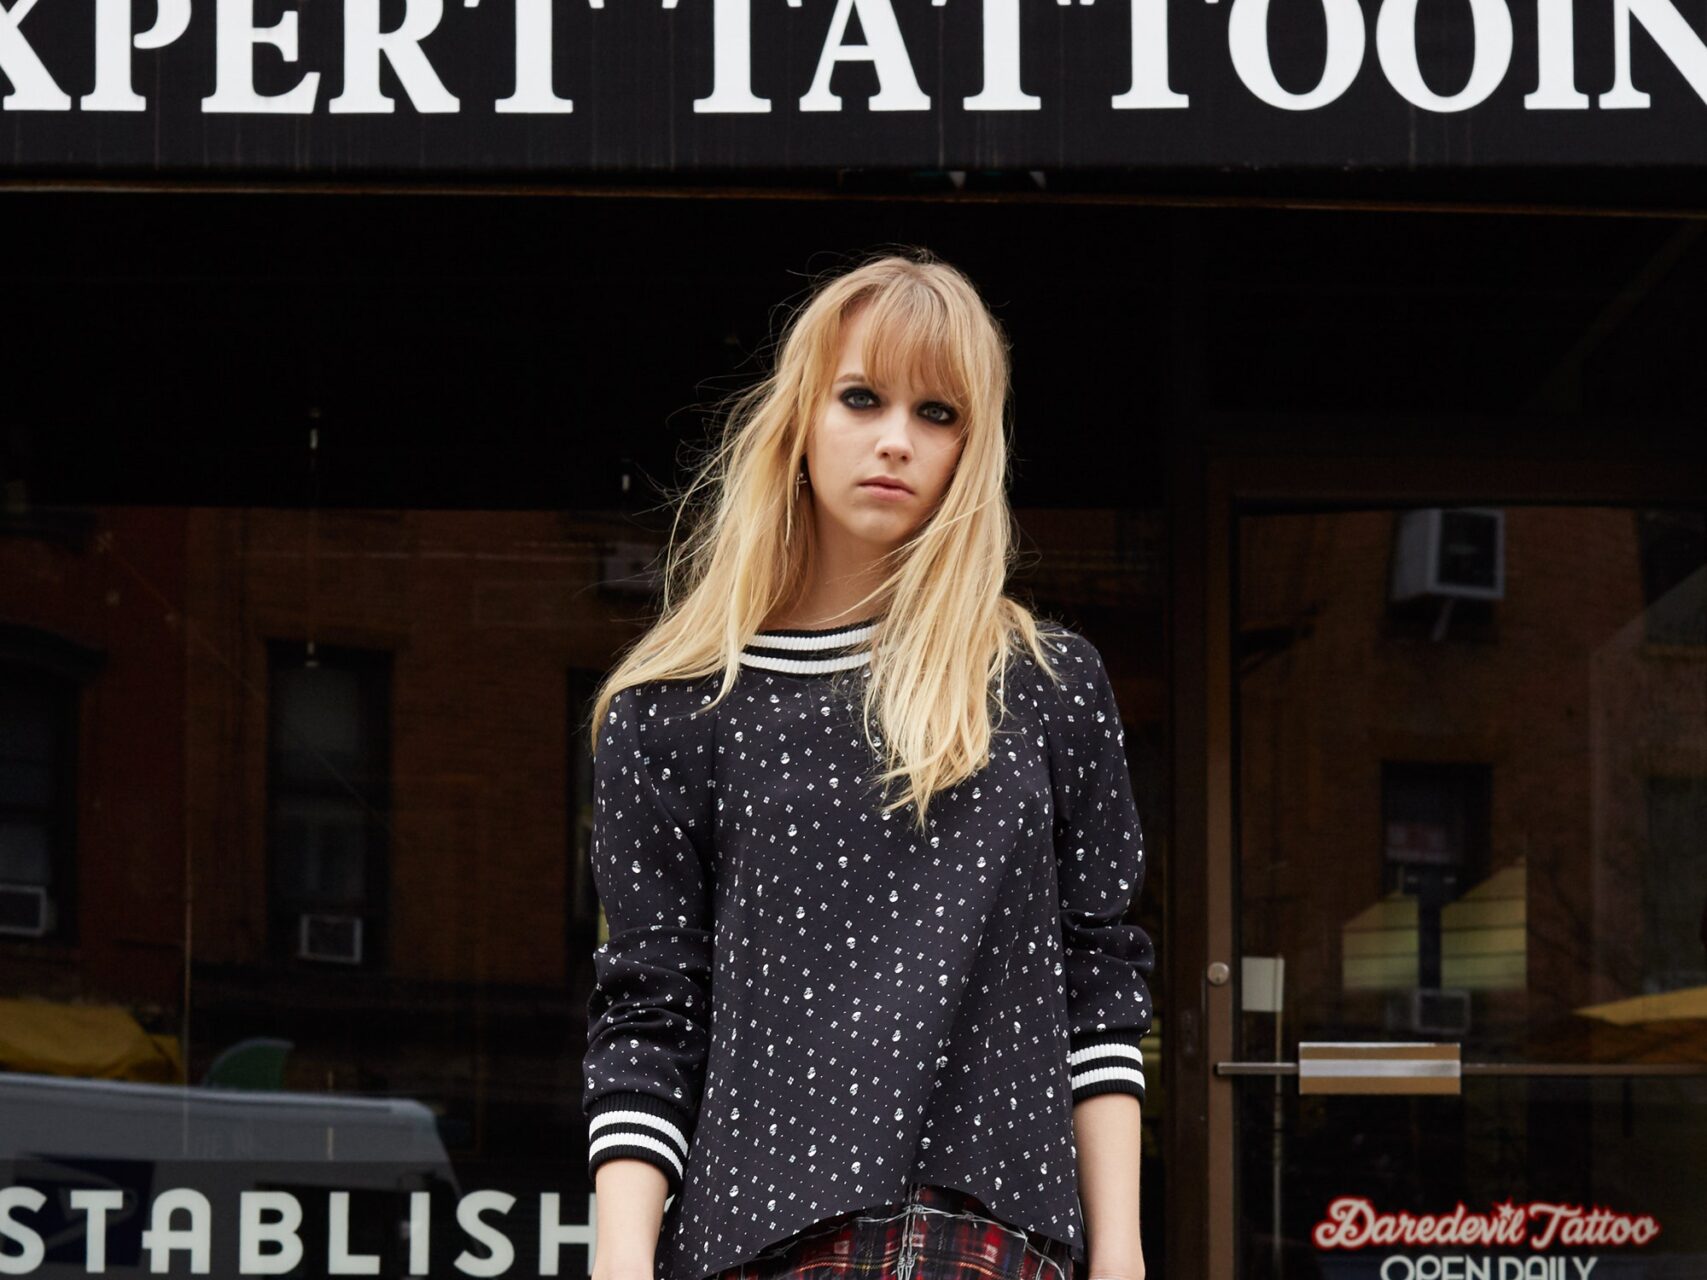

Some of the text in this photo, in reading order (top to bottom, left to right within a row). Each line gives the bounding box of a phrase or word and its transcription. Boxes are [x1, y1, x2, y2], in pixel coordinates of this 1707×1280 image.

[0, 1187, 676, 1276] STABLISH
[1312, 1195, 1661, 1249] Daredevil Tattoo
